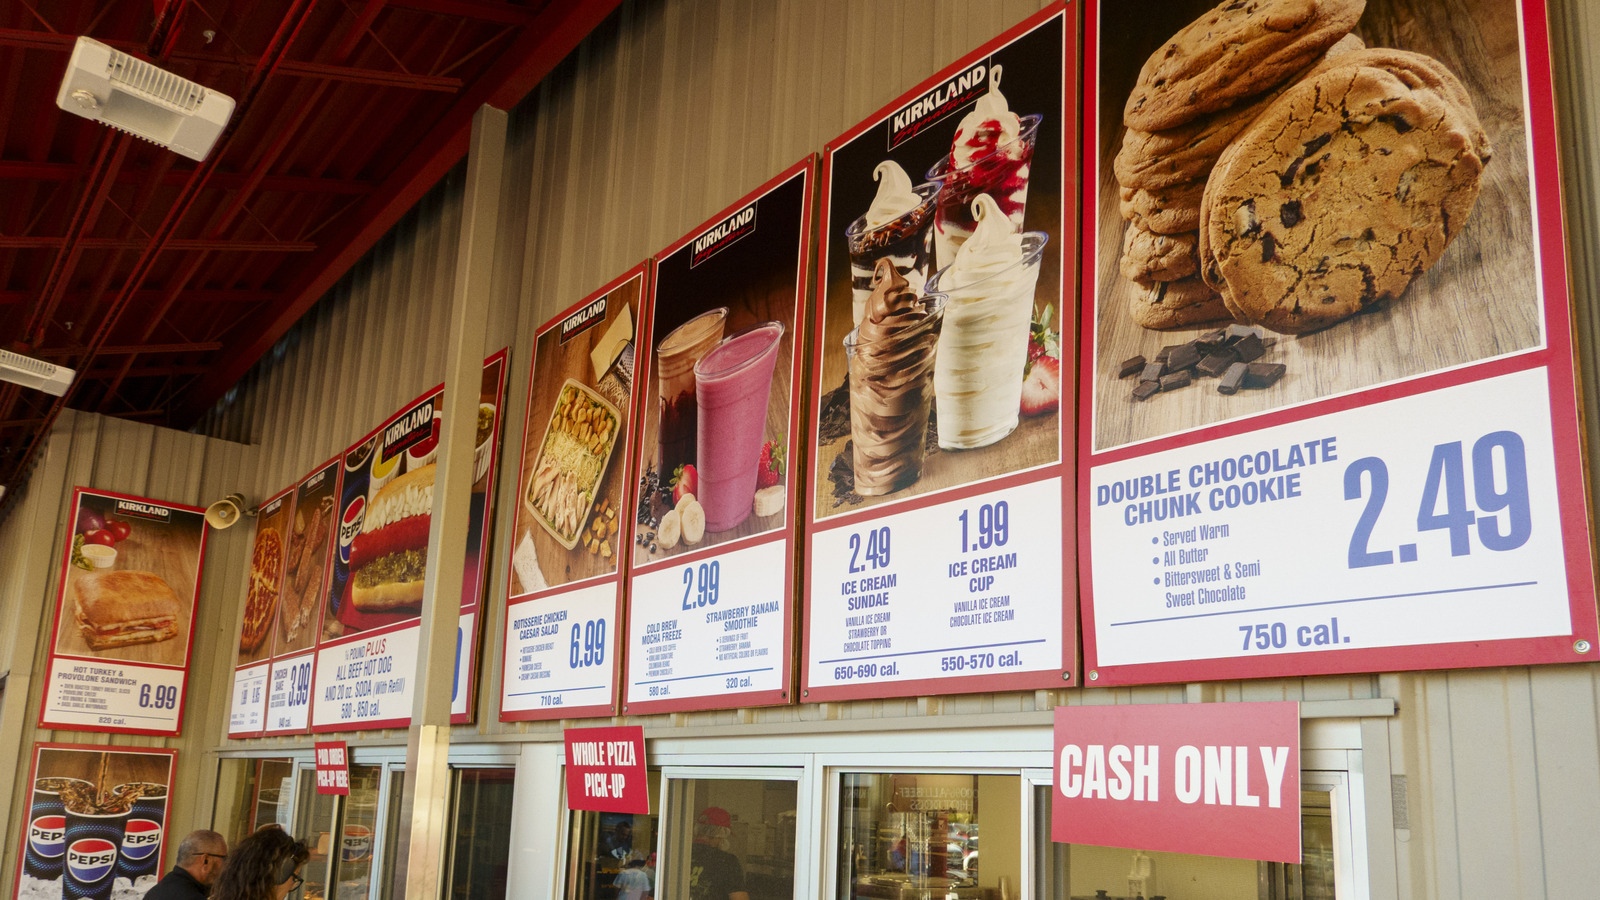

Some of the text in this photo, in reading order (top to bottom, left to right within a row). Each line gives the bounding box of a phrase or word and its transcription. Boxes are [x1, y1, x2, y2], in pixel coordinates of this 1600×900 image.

[894, 65, 986, 133] KIRKLAND
[695, 207, 754, 254] KIRKLAND
[563, 299, 606, 334] KIRKLAND
[385, 403, 432, 448] KIRKLAND
[1097, 436, 1338, 506] DOUBLE CHOCOLATE
[118, 501, 169, 517] KIRKLAND
[1124, 472, 1301, 526] CHUNK COOKIE
[1343, 430, 1532, 570] 2.49
[958, 500, 1008, 553] 1.99
[1163, 523, 1229, 547] Served Warm
[849, 526, 890, 574] 2.49
[1164, 546, 1208, 567] All Butter
[948, 552, 1016, 577] ICE CREAM
[1165, 560, 1260, 588] Bittersweet & Semi
[682, 560, 719, 611] 2.99
[841, 574, 896, 595] ICE CREAM
[969, 576, 994, 592] CUP
[847, 592, 889, 611] SUNDAE
[953, 595, 1009, 613] VANILLA ICE CREAM
[1165, 583, 1246, 609] Sweet Chocolate
[514, 610, 567, 630] ROTISSERIE CHICKEN
[706, 601, 779, 623] STRAWBERRY BANANA
[845, 615, 863, 627] VANILLA
[873, 612, 890, 623] CREAM
[949, 609, 1014, 628] CHOCOLATE ICE CREAM
[520, 624, 558, 641] CAESAR SALAD
[647, 619, 678, 634] COLD BREW
[724, 616, 758, 632] SMOOTHIE
[848, 625, 887, 639] STRAWBERRY OR
[1239, 617, 1350, 651] 750 cal.
[570, 618, 606, 669] 6.99
[642, 629, 682, 645] MOCHA FREEZE
[843, 638, 891, 653] CHOCOLATE TOPPING
[350, 646, 365, 660] POUND
[366, 638, 386, 657] PLUS
[74, 666, 89, 674] HOT
[90, 667, 116, 676] TURKEY
[336, 656, 392, 681] ALL BEEF HOT DOG
[834, 662, 899, 680] 650-690 cal.
[941, 650, 1021, 671] 550-570 cal.
[58, 672, 137, 685] PROVOLONE SANDWICH
[288, 662, 310, 707] 3.99
[726, 676, 752, 688] 320 cal.
[139, 684, 177, 709] 6.99
[325, 686, 336, 701] AND
[337, 684, 344, 700] 20
[345, 686, 353, 699] oz.
[355, 680, 371, 697] SODA
[541, 694, 563, 705] 710 cal.
[649, 685, 670, 696] 580 cal.
[341, 703, 352, 719] 580
[357, 701, 368, 717] 850
[370, 699, 381, 716] cal.
[318, 748, 344, 765] PAID ORDER
[572, 741, 636, 766] WHOLE PIZZA
[318, 770, 348, 787] PICK-UP HERE
[584, 773, 625, 798] PICK-UP
[1060, 744, 1290, 808] CASH ONLY
[32, 830, 65, 840] PEP
[123, 833, 159, 844] EPSI
[70, 853, 113, 865] PEPSI
